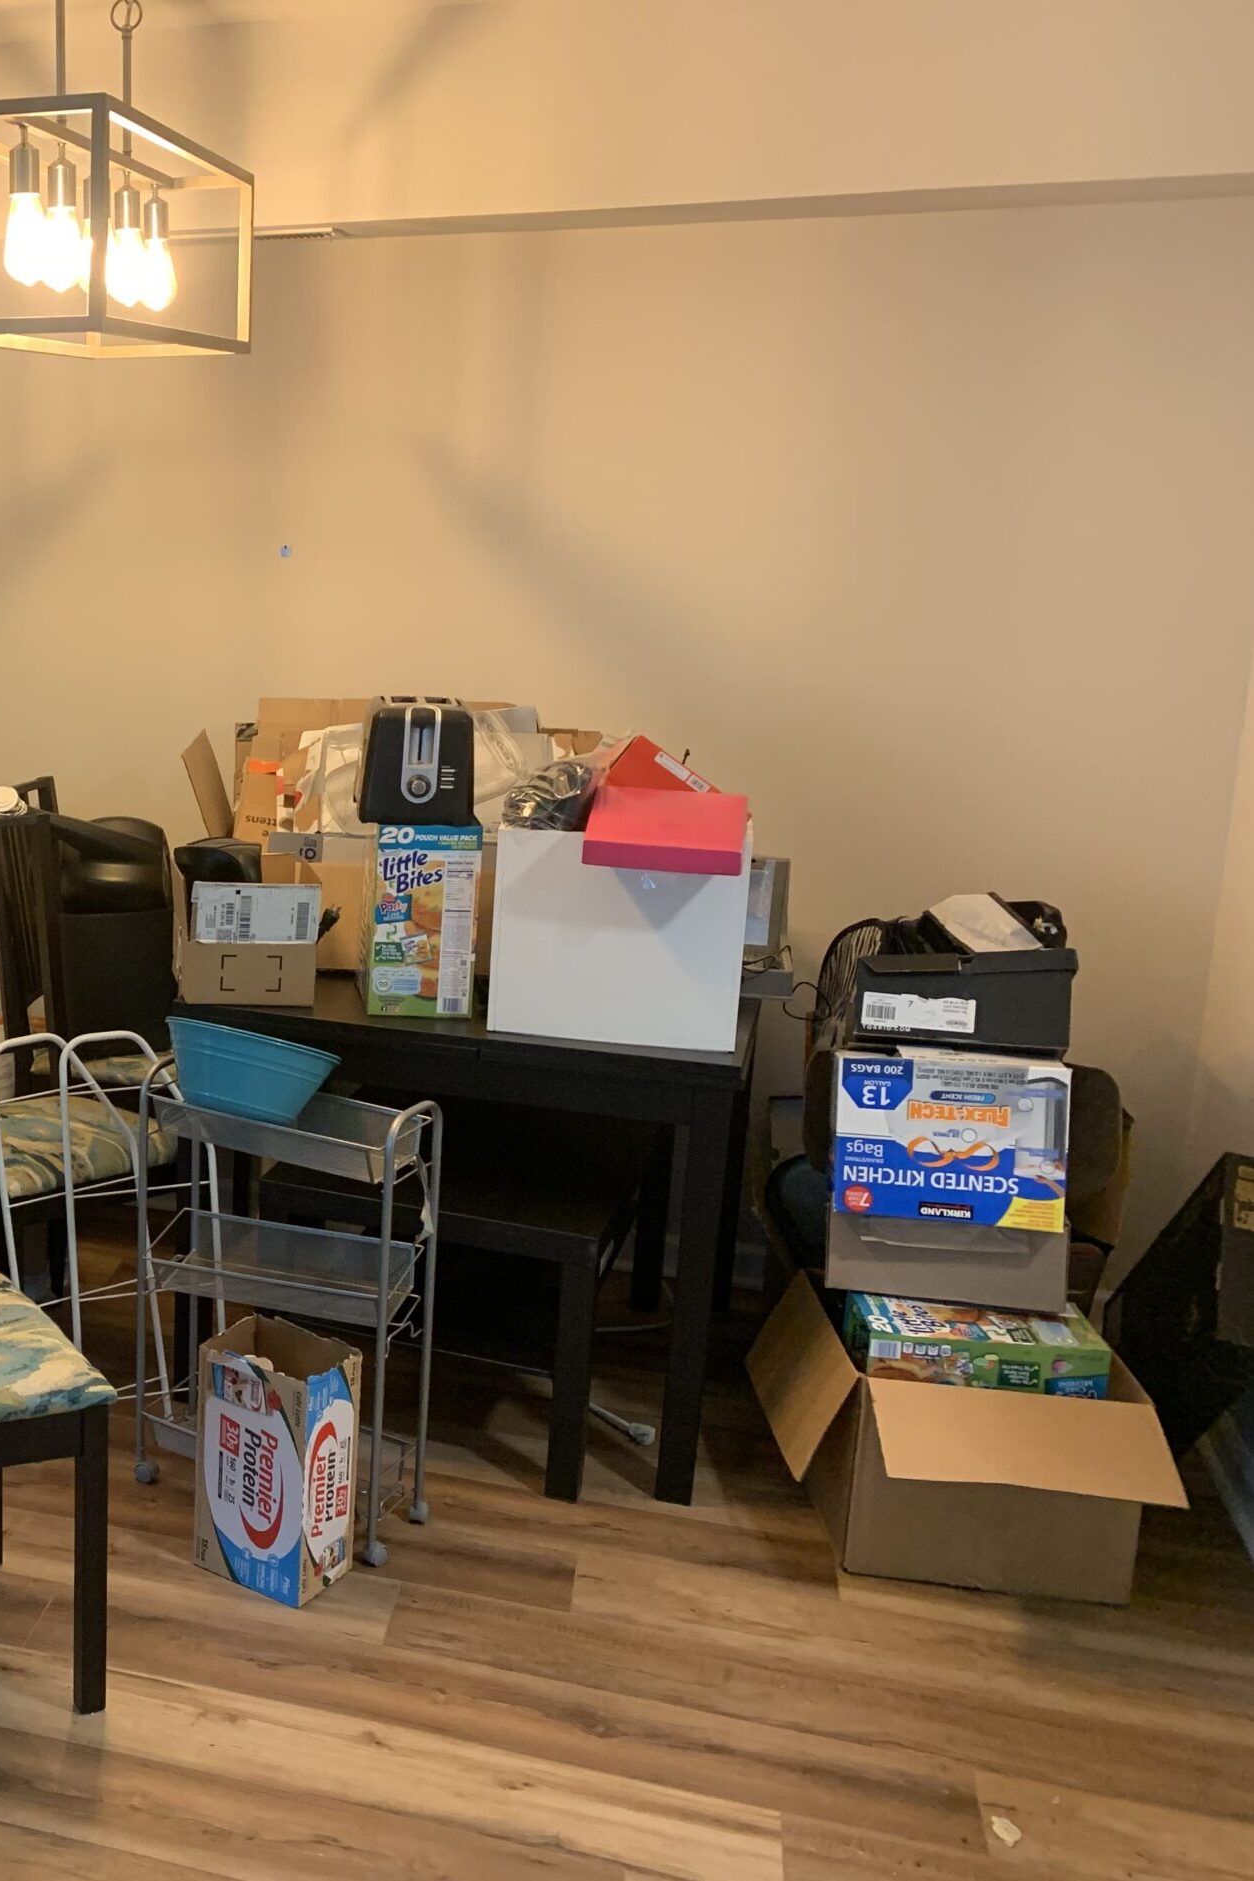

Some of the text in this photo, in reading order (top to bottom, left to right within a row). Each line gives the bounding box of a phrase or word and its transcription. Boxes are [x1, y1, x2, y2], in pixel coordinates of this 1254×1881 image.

[379, 826, 478, 844] 20 POUCH VALUE PACK
[383, 850, 428, 881] Little
[396, 868, 444, 894] Bites
[850, 1063, 881, 1074] BAGS
[883, 1065, 904, 1075] 200
[862, 1085, 891, 1106] 13
[941, 1092, 986, 1102] FRESH SCENT
[847, 1139, 884, 1157] Bags
[843, 1164, 1019, 1195] SCENTED KITCHEN
[860, 1192, 870, 1207] 7
[920, 1206, 972, 1218] KIRKLAND
[867, 1315, 895, 1333] 20
[226, 1425, 239, 1450] 30g
[242, 1428, 262, 1508] Protein
[258, 1429, 278, 1525] Premier
[310, 1455, 326, 1538] Premier
